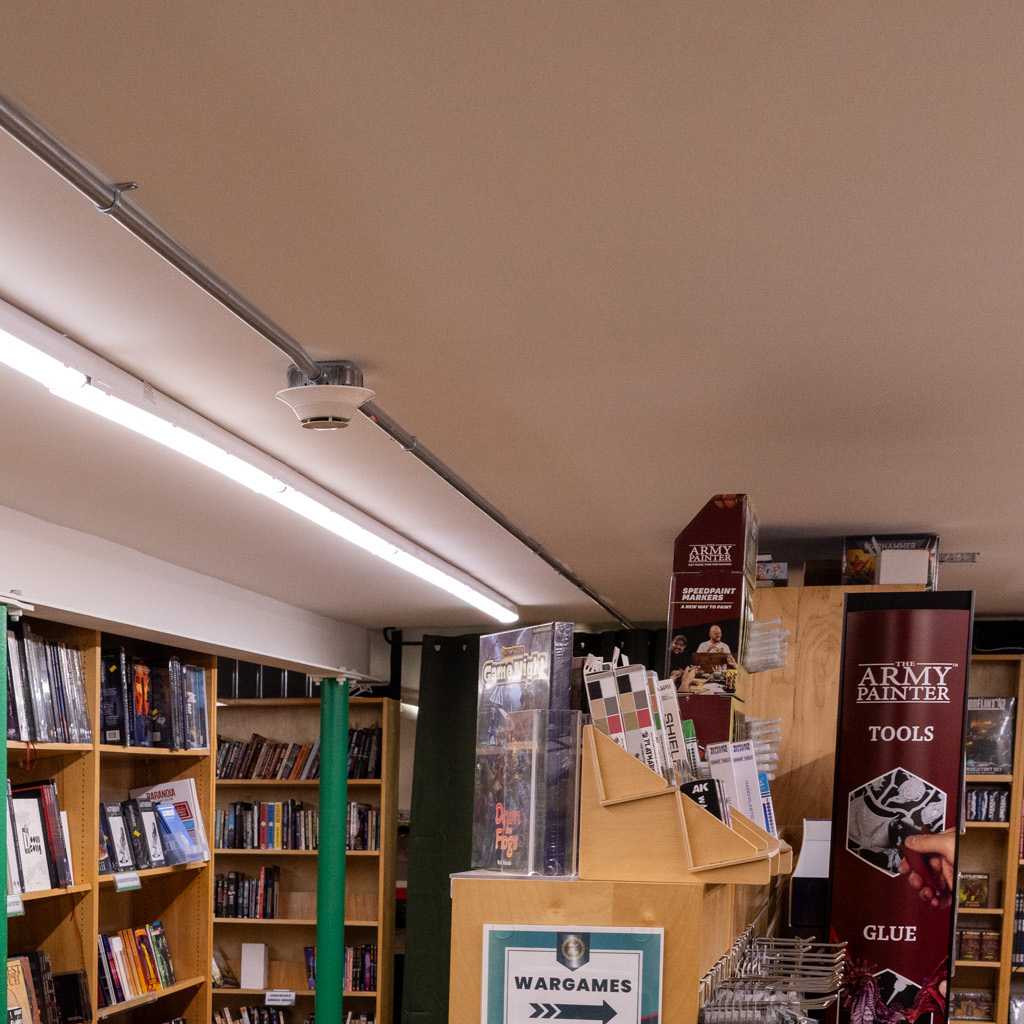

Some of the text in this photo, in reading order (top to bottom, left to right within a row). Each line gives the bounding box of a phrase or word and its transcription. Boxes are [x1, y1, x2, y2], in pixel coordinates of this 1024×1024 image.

[691, 546, 732, 555] ARMY
[858, 667, 952, 686] ARMY
[857, 687, 950, 700] PAINTER
[664, 712, 681, 763] SHIEL
[869, 726, 934, 741] TOOLS
[147, 788, 175, 799] PARANOIA
[692, 783, 708, 794] AK
[863, 925, 917, 941] GLUE
[515, 977, 632, 992] WARGAMES
